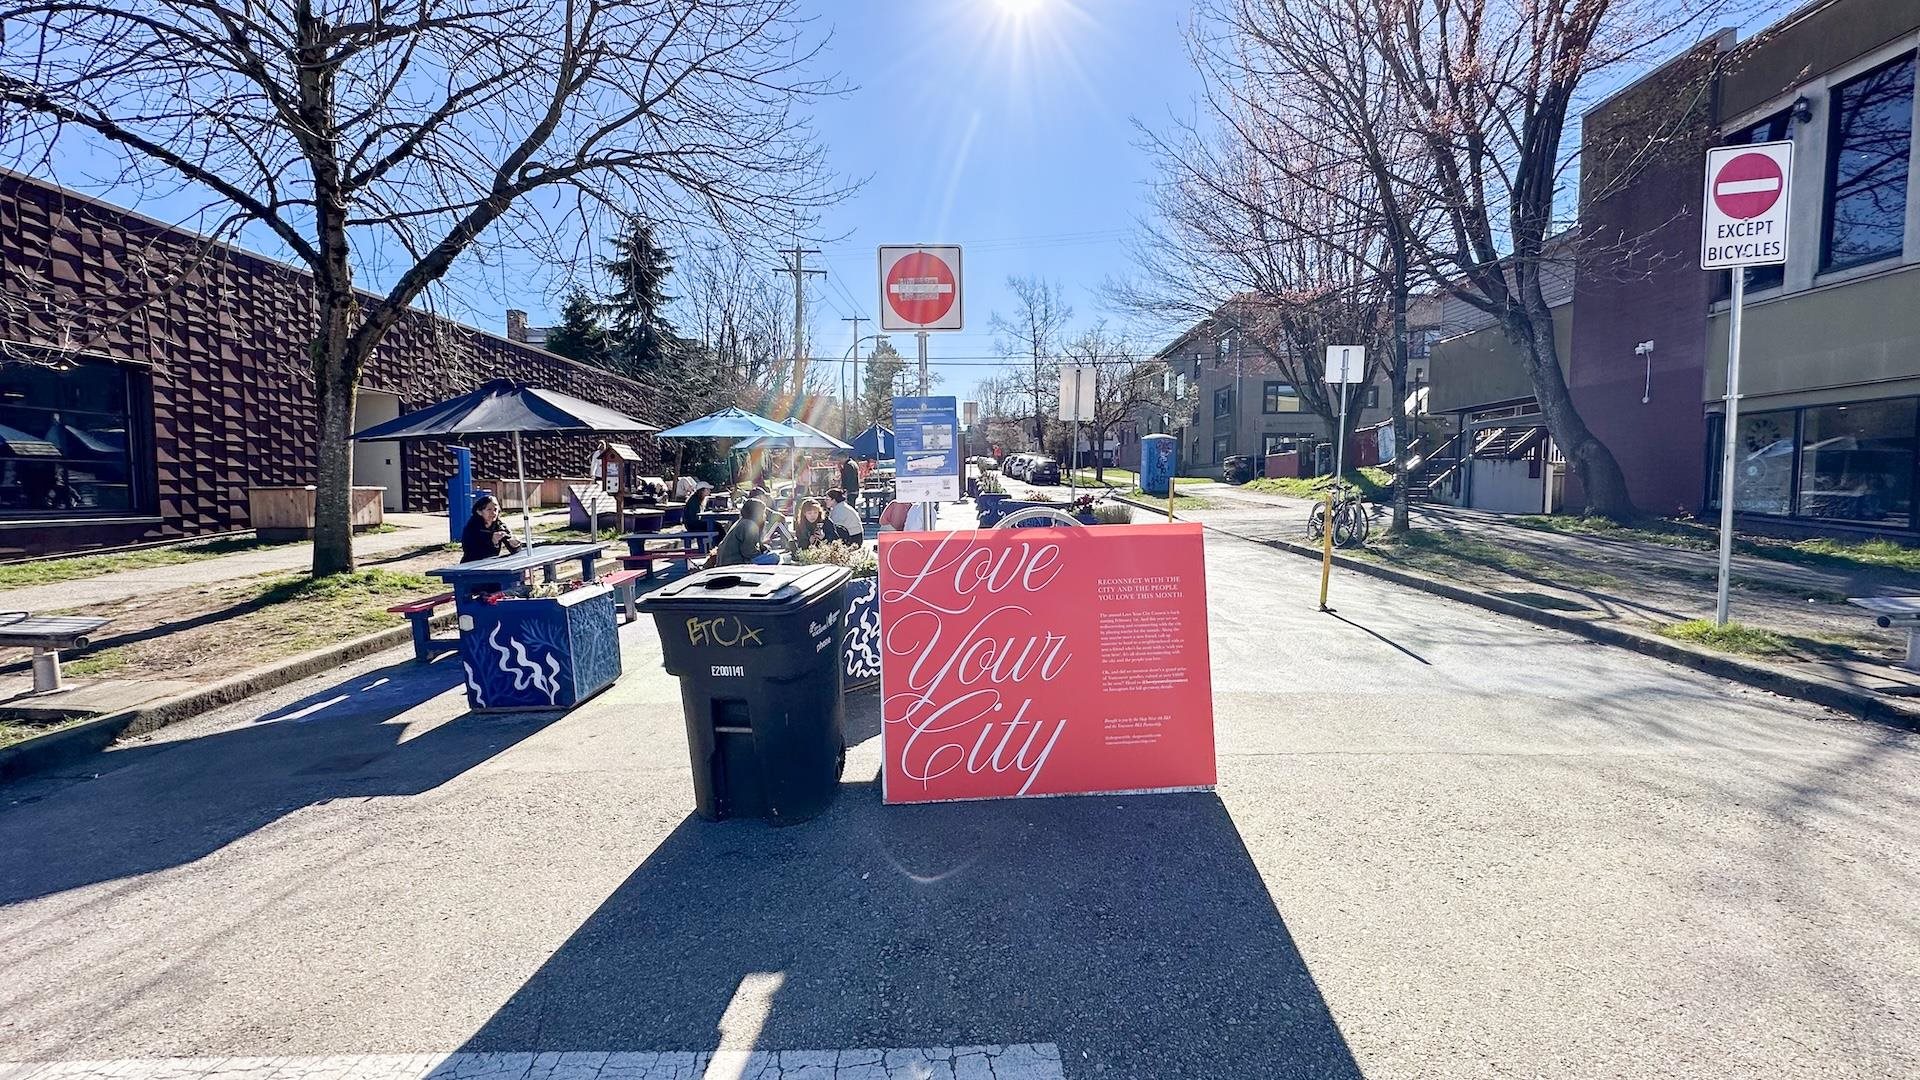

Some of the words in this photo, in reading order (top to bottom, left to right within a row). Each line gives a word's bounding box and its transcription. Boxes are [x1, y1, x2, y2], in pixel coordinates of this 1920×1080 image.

[1717, 220, 1774, 239] EXCEPT
[1708, 241, 1781, 261] BICYCLES
[882, 530, 1064, 614] Love
[1097, 577, 1142, 585] RECONNECT
[1156, 591, 1183, 599] MONTH
[711, 665, 744, 677] E2001141
[884, 605, 1072, 723] Your
[902, 689, 1066, 796] City
